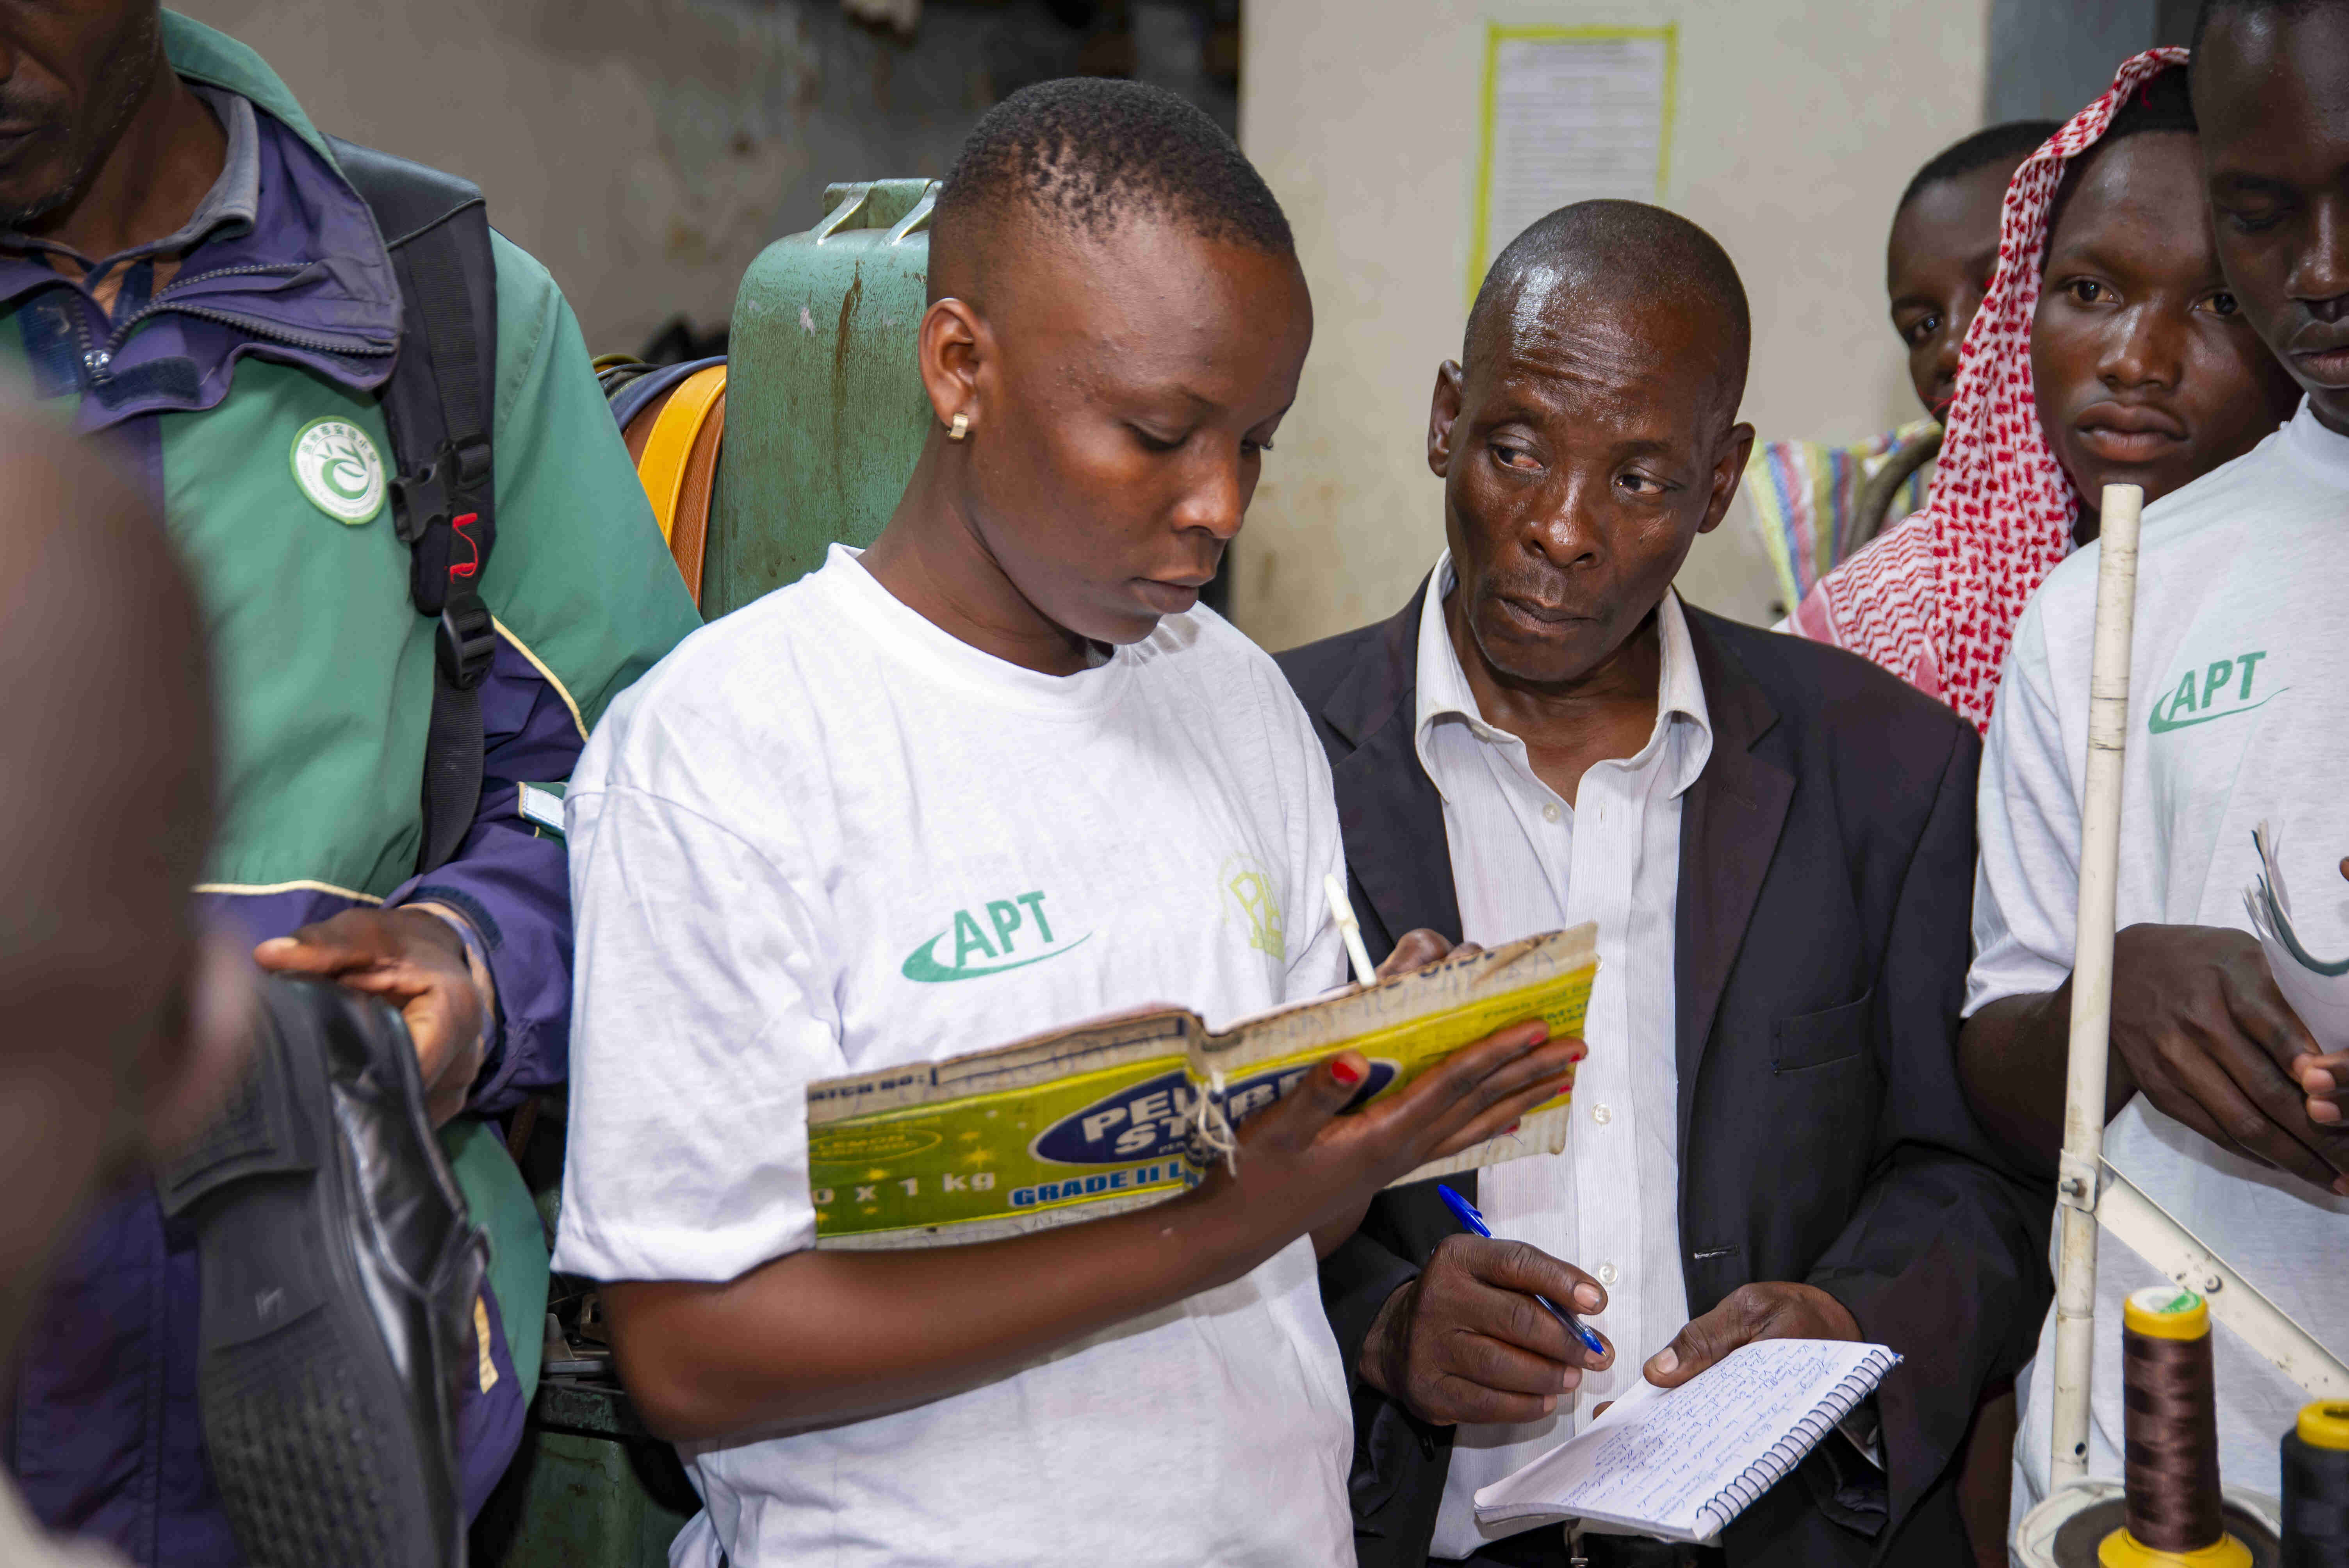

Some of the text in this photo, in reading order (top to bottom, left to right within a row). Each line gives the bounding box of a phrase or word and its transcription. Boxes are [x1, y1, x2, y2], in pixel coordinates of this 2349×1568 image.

[2167, 650, 2267, 721] APT
[954, 890, 1054, 968] APT
[855, 1184, 876, 1202] x
[898, 1177, 918, 1197] 1
[942, 1172, 996, 1192] kg
[1011, 1170, 1128, 1206] GRADE
